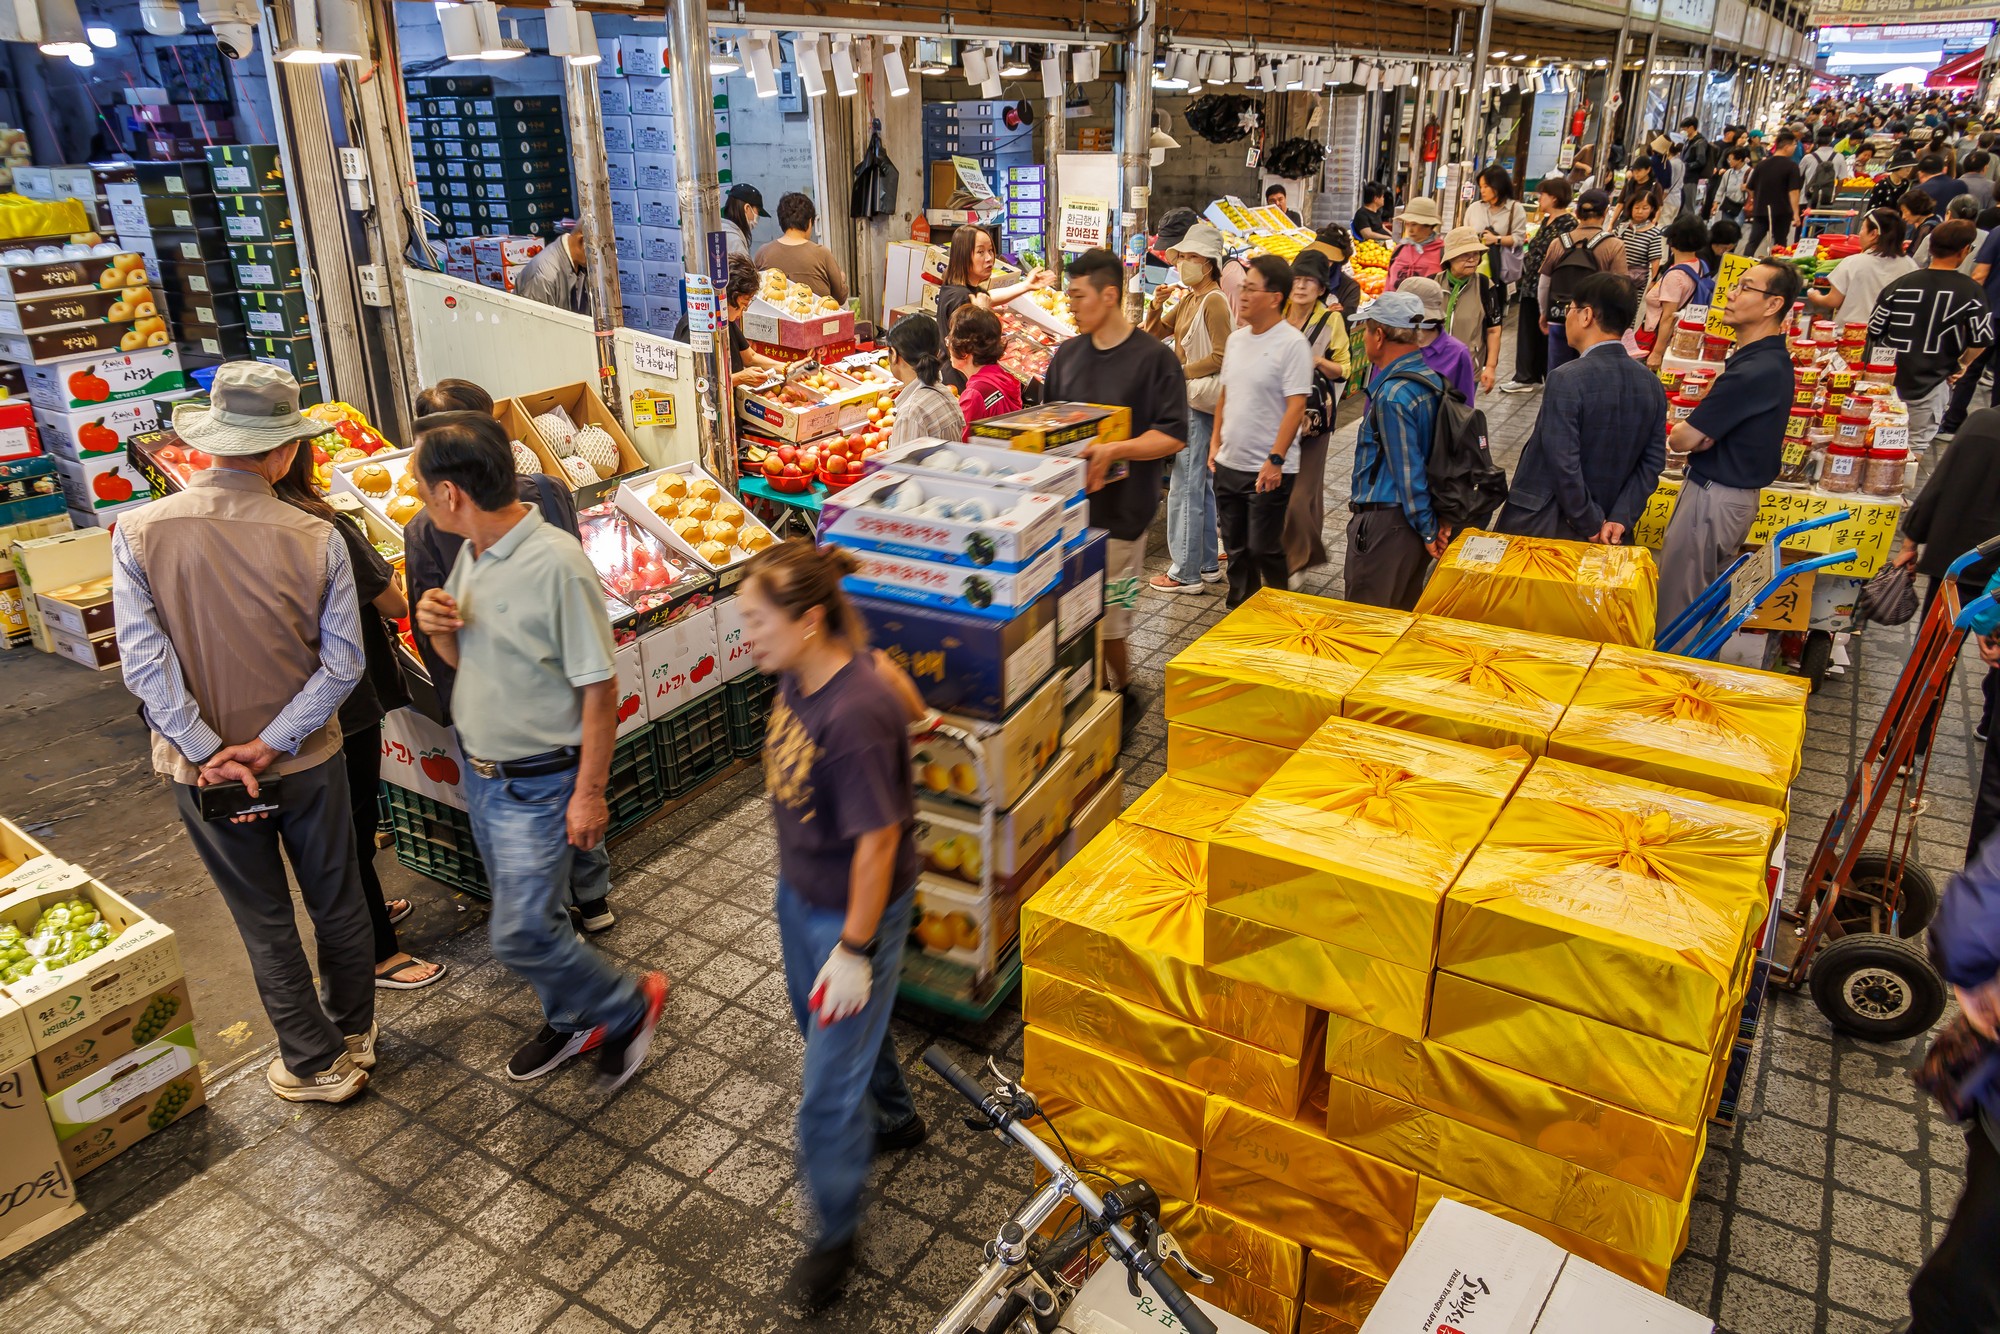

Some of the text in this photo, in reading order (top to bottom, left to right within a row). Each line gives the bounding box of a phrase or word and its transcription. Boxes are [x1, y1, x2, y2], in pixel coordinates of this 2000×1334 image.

[1066, 213, 1101, 227] 환급행사
[1065, 226, 1099, 240] 참여점포
[123, 366, 155, 382] 사과
[1760, 493, 1828, 515] 오징어젓
[1835, 528, 1884, 550] 꼴뚜기
[648, 607, 670, 624] 사과
[656, 673, 687, 698] 사과
[114, 929, 157, 953] 샤인머스켓
[41, 1009, 87, 1039] 샤인머스켓
[55, 1052, 101, 1081] 샤인머스켓
[75, 1140, 117, 1169] 샤인머스켓
[1422, 1268, 1461, 1333] FRESH YEONGJU APPLE
